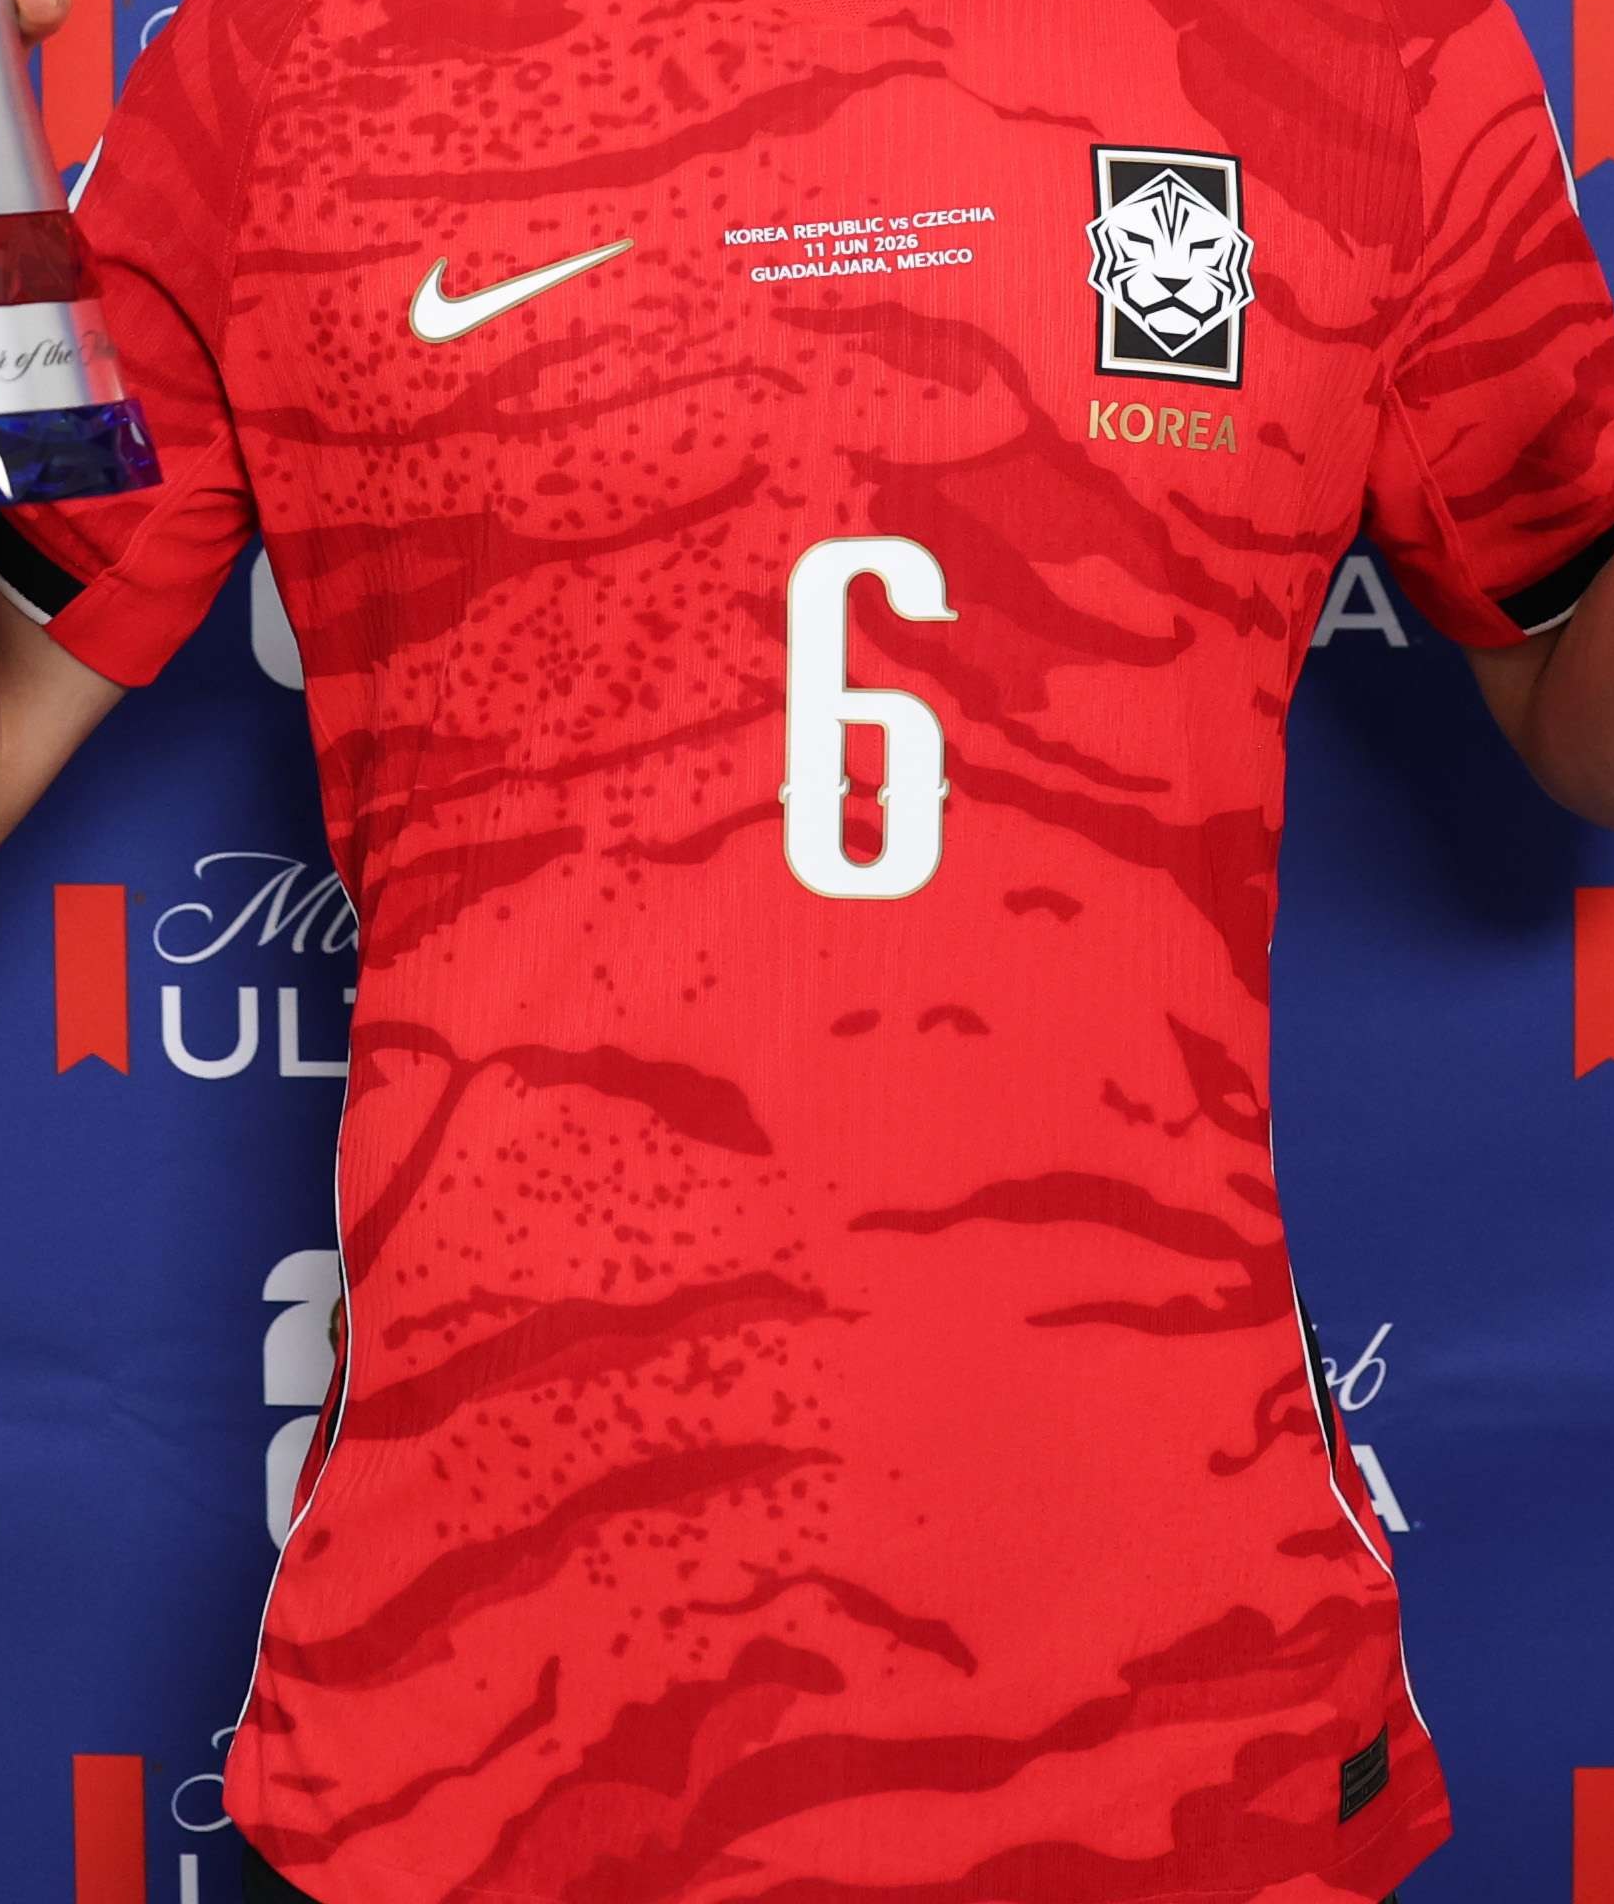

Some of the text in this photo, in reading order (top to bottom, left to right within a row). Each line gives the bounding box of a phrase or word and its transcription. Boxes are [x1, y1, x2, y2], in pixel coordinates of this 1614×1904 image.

[724, 207, 995, 245] KOREA REPUBLIC vs CZECHIA
[803, 234, 919, 258] 11 JUN 2026
[750, 248, 973, 283] GUADALAJARA, MEXICO
[0, 338, 52, 382] of
[42, 340, 73, 366] the
[1088, 399, 1238, 454] KOREA
[778, 535, 960, 900] 6
